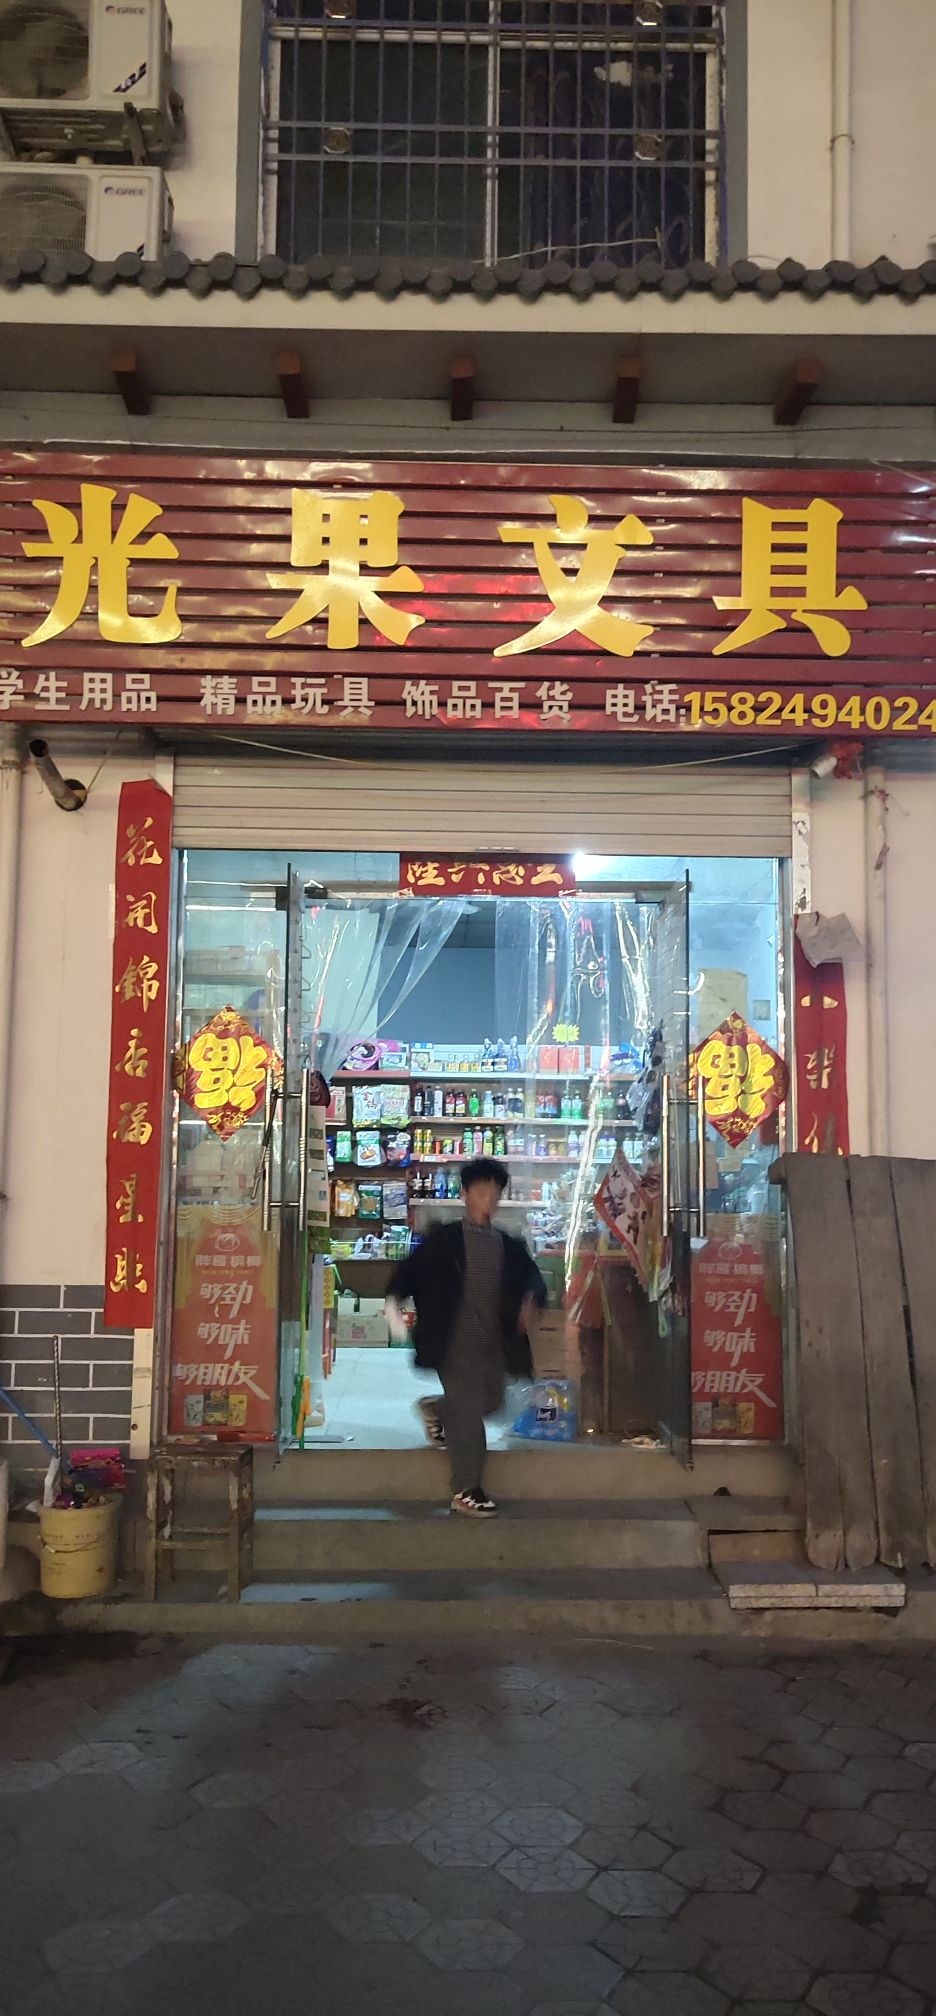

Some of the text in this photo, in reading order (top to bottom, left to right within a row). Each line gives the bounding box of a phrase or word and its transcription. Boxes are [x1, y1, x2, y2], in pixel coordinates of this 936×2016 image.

[117, 7, 146, 15] GREE
[116, 188, 144, 196] GREE
[21, 483, 868, 658] 光果文具
[0, 671, 158, 712] 学生用品
[200, 676, 375, 718] 精品玩具
[401, 681, 574, 722] 饰品百货
[683, 692, 936, 733] 1582494024
[189, 1032, 267, 1112] 福
[697, 1039, 776, 1118] 福
[200, 1280, 254, 1319] 够劲
[704, 1288, 757, 1327] 够劲
[197, 1321, 251, 1360] 够味
[704, 1327, 756, 1368] 够味
[175, 1360, 270, 1400] 够朋友
